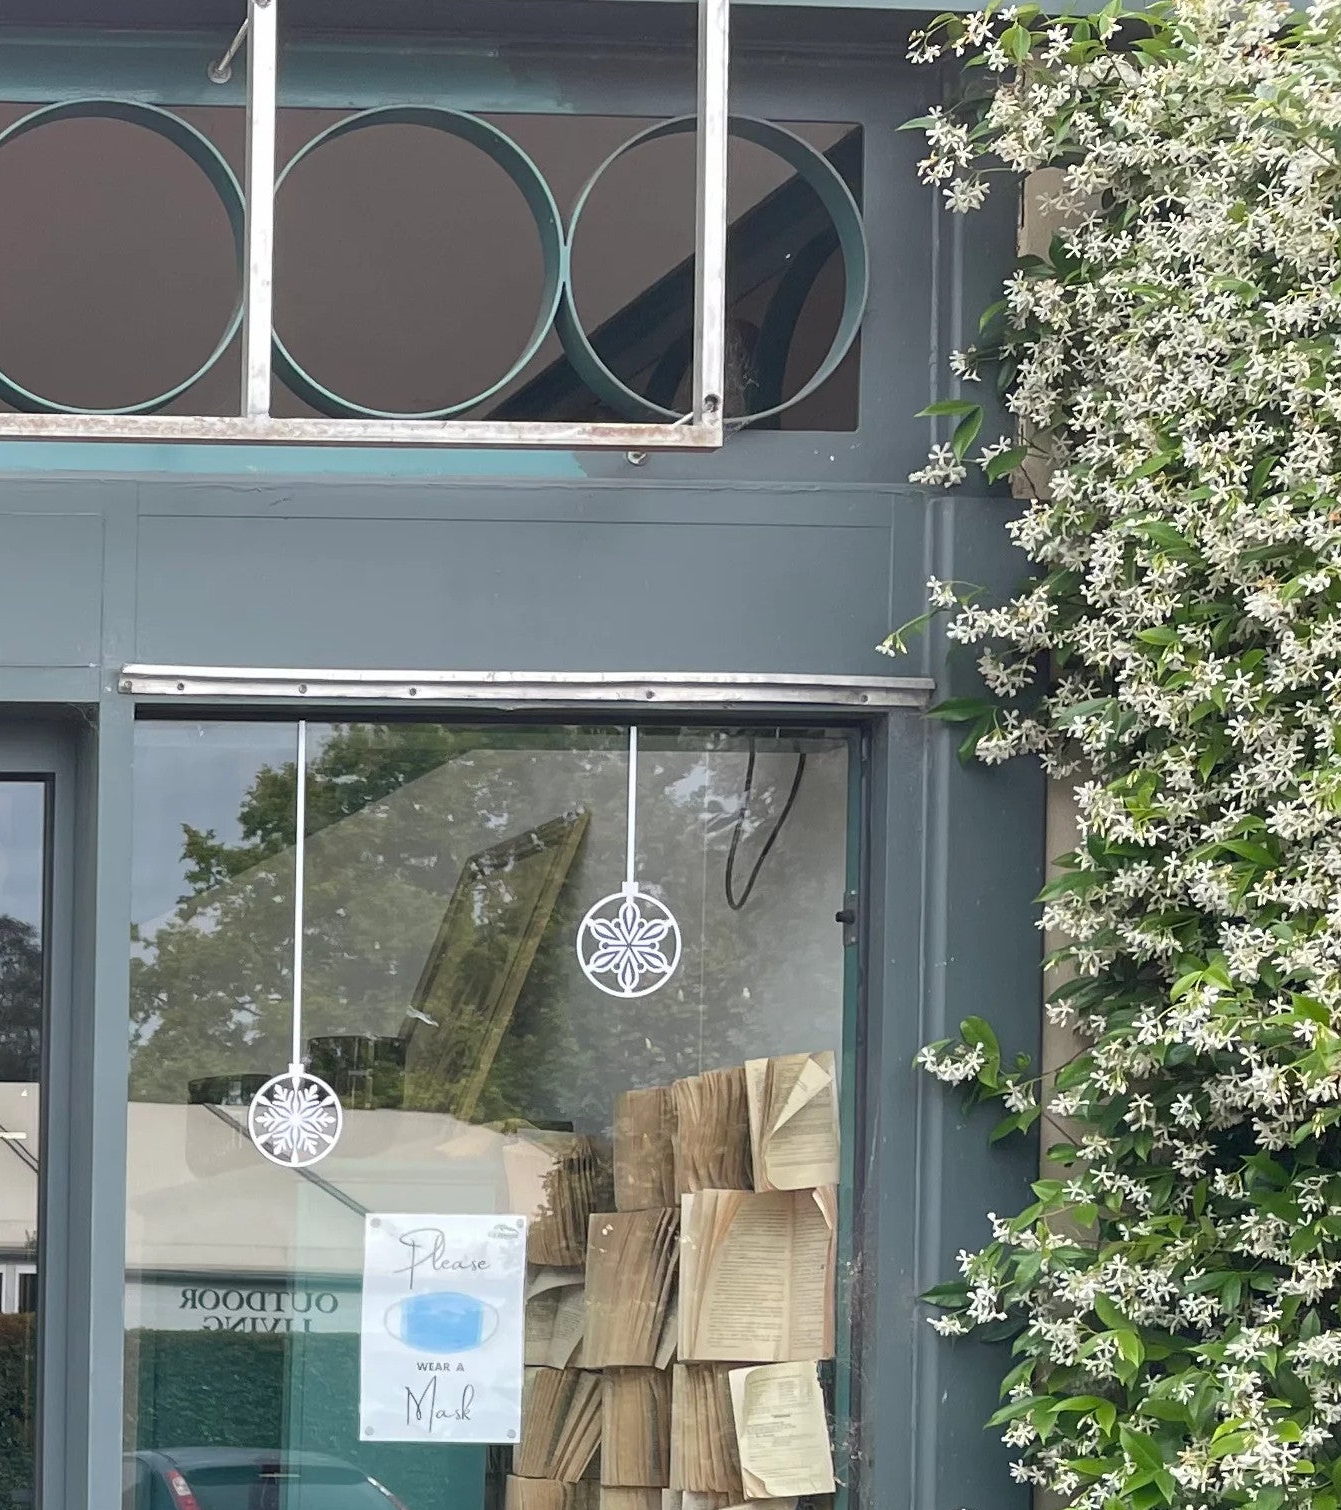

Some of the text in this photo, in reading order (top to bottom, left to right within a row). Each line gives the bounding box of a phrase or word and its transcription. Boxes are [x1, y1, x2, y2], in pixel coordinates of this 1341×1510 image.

[393, 1227, 491, 1290] Please
[417, 1362, 465, 1372] WEAR A
[404, 1375, 476, 1433] Mask
